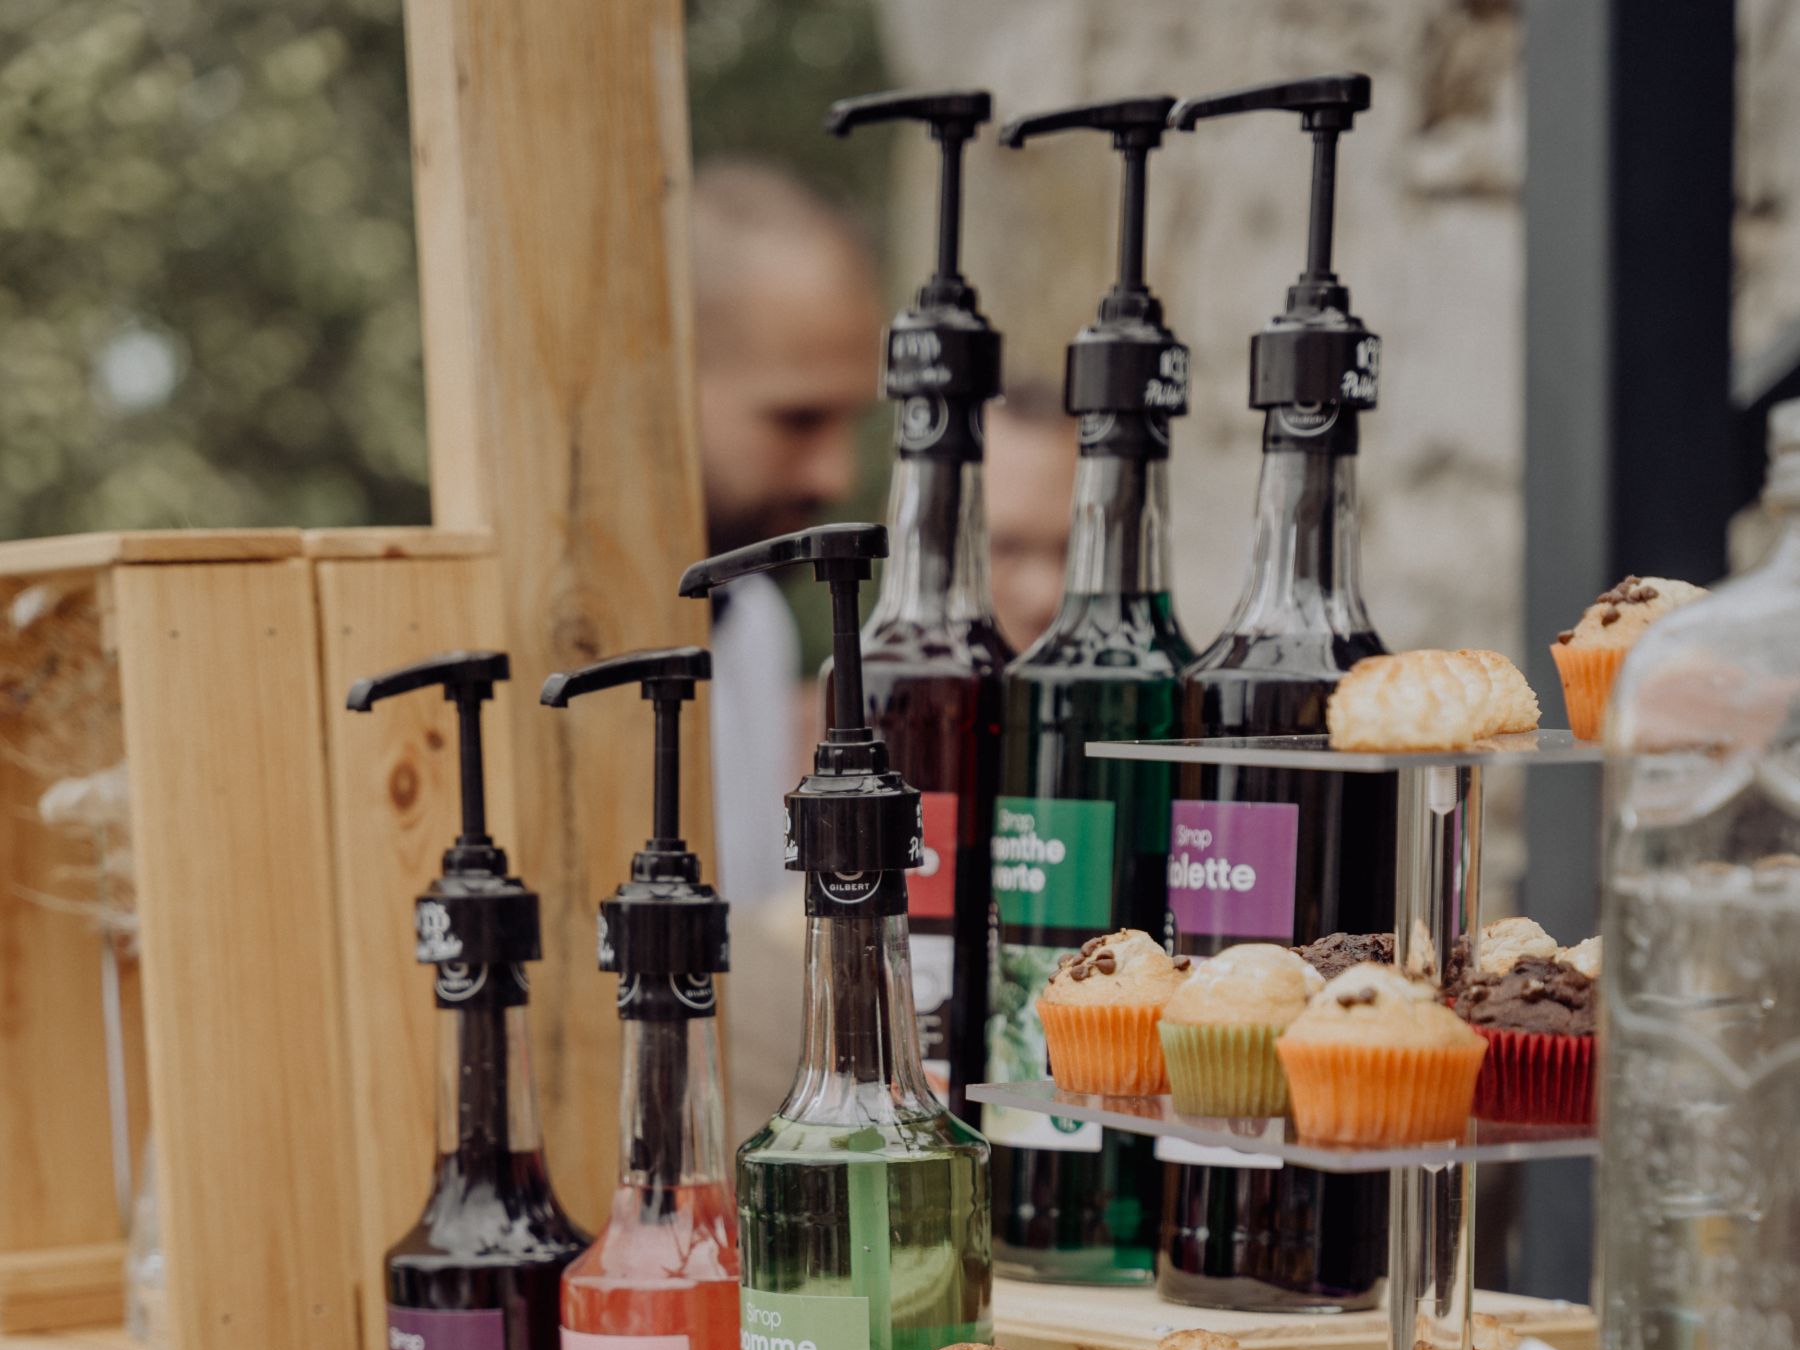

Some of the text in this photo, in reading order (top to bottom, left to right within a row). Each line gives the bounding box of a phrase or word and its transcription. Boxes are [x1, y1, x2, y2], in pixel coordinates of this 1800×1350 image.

[1176, 823, 1212, 851] Sirop
[829, 882, 870, 891] GILBERT
[746, 1302, 782, 1332] Sirop
